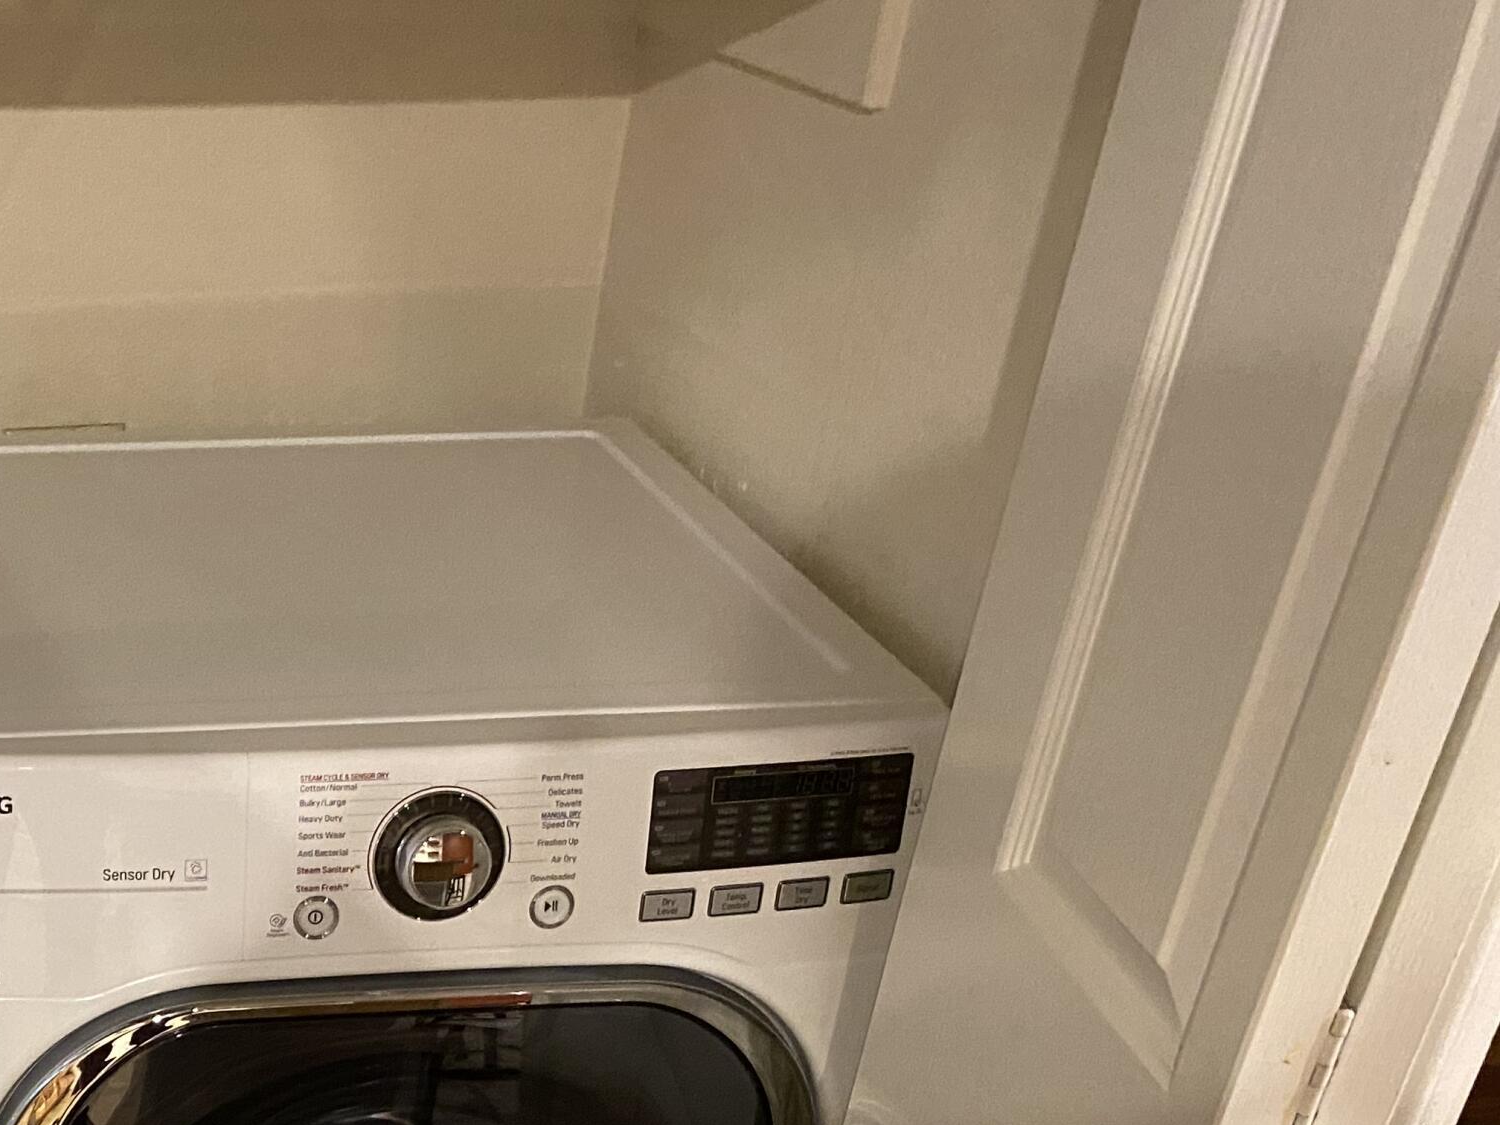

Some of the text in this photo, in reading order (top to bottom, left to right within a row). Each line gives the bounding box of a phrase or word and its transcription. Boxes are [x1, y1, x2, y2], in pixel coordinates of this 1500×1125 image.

[300, 784, 357, 793] Cotton/Normal
[548, 788, 583, 796] Delicates
[542, 820, 580, 829] Speed Dry
[298, 832, 324, 841] Sports
[563, 854, 577, 863] Dry
[102, 867, 175, 882] Sensor Dry
[296, 866, 321, 875] Steam
[296, 885, 320, 893] Steam
[661, 897, 677, 906] Dry
[656, 907, 678, 916] Level
